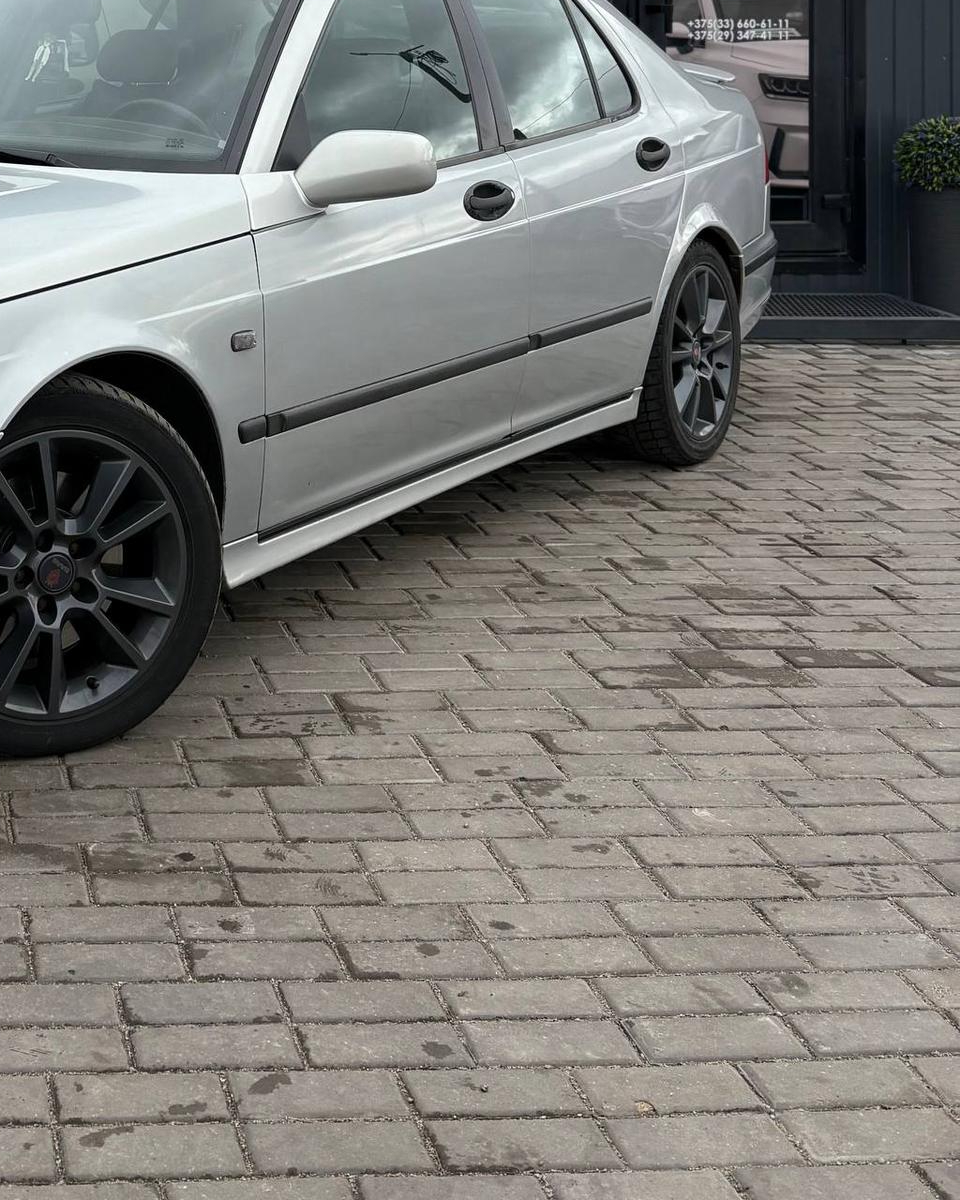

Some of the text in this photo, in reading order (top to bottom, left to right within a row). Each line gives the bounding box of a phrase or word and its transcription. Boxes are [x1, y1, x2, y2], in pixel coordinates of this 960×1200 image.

[688, 19, 789, 31] +375(33) 660-61-11
[688, 31, 734, 42] +375(29)
